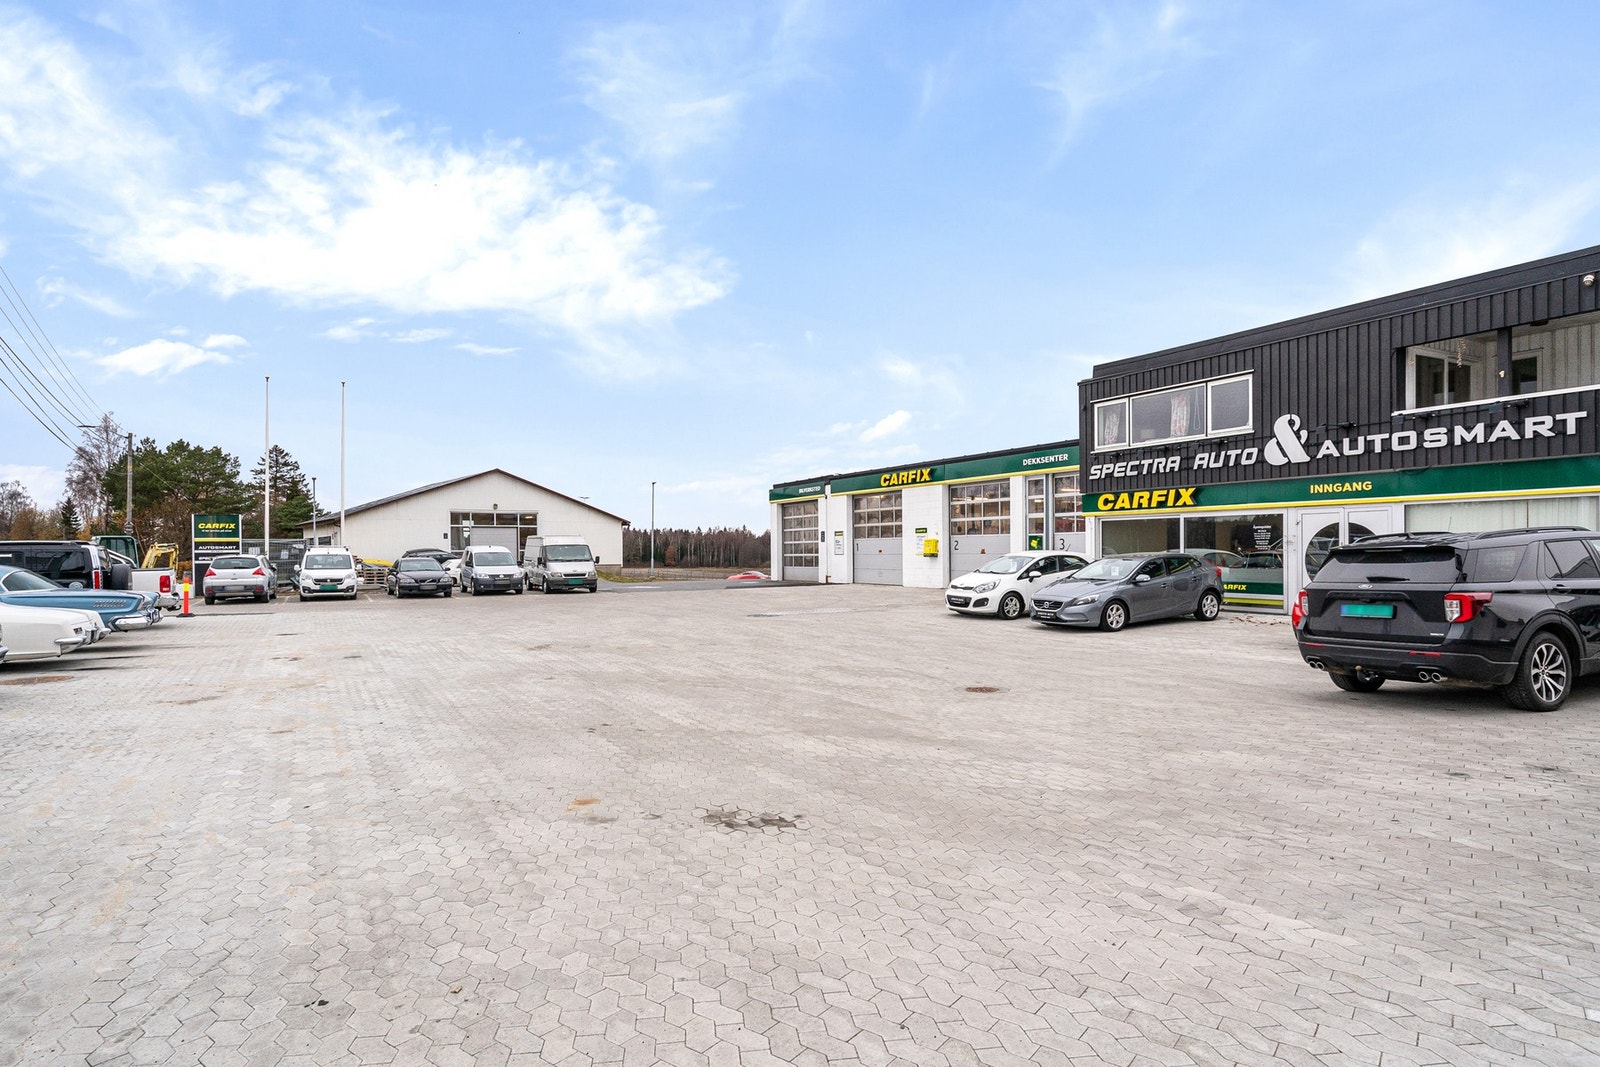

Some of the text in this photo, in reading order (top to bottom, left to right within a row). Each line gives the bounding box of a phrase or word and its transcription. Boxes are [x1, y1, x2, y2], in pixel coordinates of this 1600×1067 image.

[1089, 411, 1587, 480] SPECTRA AUTO & AUTOSMART
[1022, 453, 1068, 466] DEKKSENTER
[880, 468, 931, 487] CARFIX
[1310, 481, 1373, 494] INNGANG
[1097, 487, 1198, 511] CARFIX
[954, 540, 959, 551] 2
[1059, 538, 1065, 550] 3
